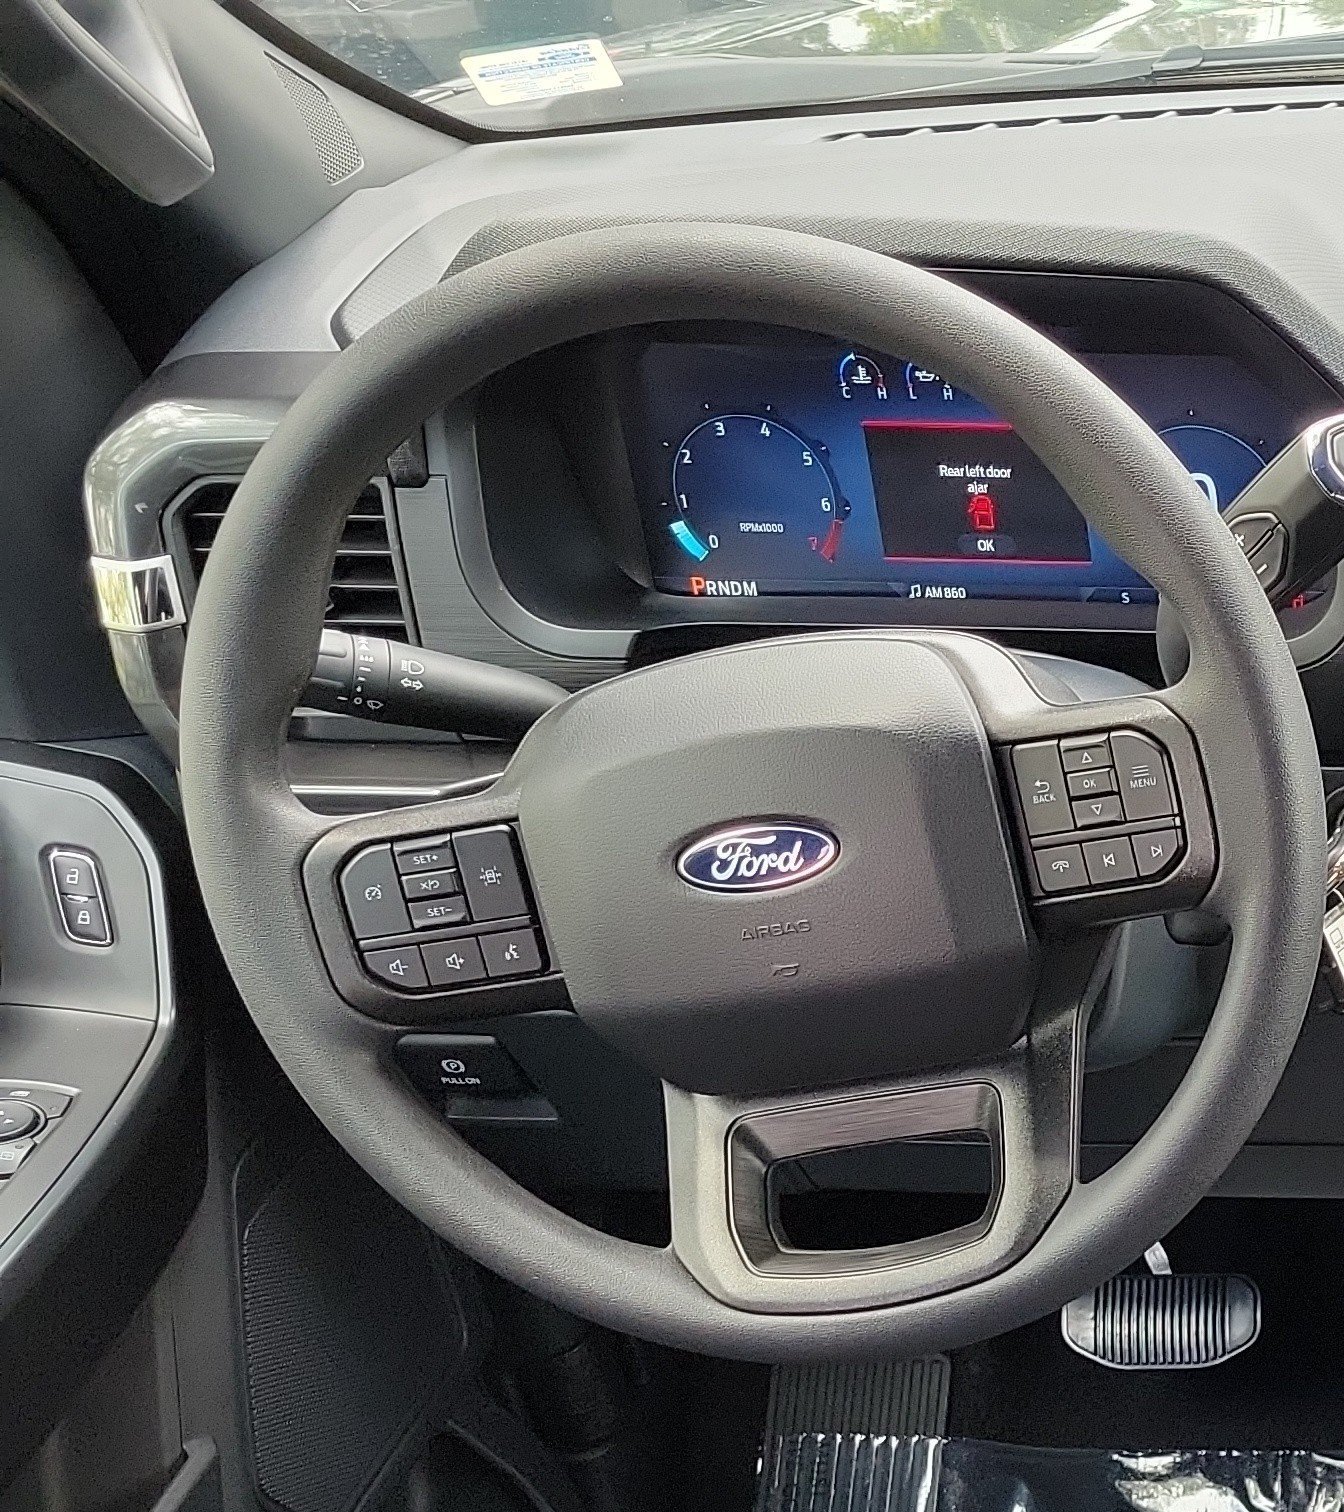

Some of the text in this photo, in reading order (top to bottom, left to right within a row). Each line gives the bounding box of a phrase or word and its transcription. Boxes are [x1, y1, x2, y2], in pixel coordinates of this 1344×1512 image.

[842, 387, 851, 399] C
[877, 387, 887, 400] H
[908, 387, 917, 400] L
[943, 388, 953, 401] H
[714, 422, 726, 436] 3
[760, 422, 771, 437] 4
[681, 449, 693, 464] 2
[802, 451, 813, 466] 5
[938, 464, 1012, 479] Rear left door
[967, 481, 989, 495] ajar
[679, 494, 688, 509] 1
[820, 497, 832, 511] 6
[739, 522, 785, 534] RPMx1000
[708, 534, 719, 549] 0
[976, 539, 995, 552] OK
[925, 587, 967, 599] AM 860
[1121, 592, 1130, 604] S
[1083, 778, 1097, 790] OK
[1129, 777, 1157, 791] MENU
[1032, 792, 1056, 805] BACK
[412, 853, 439, 866] SET+
[709, 836, 805, 882] Ford
[740, 920, 812, 942] AIRBAG
[440, 1076, 481, 1085] PULL ON
